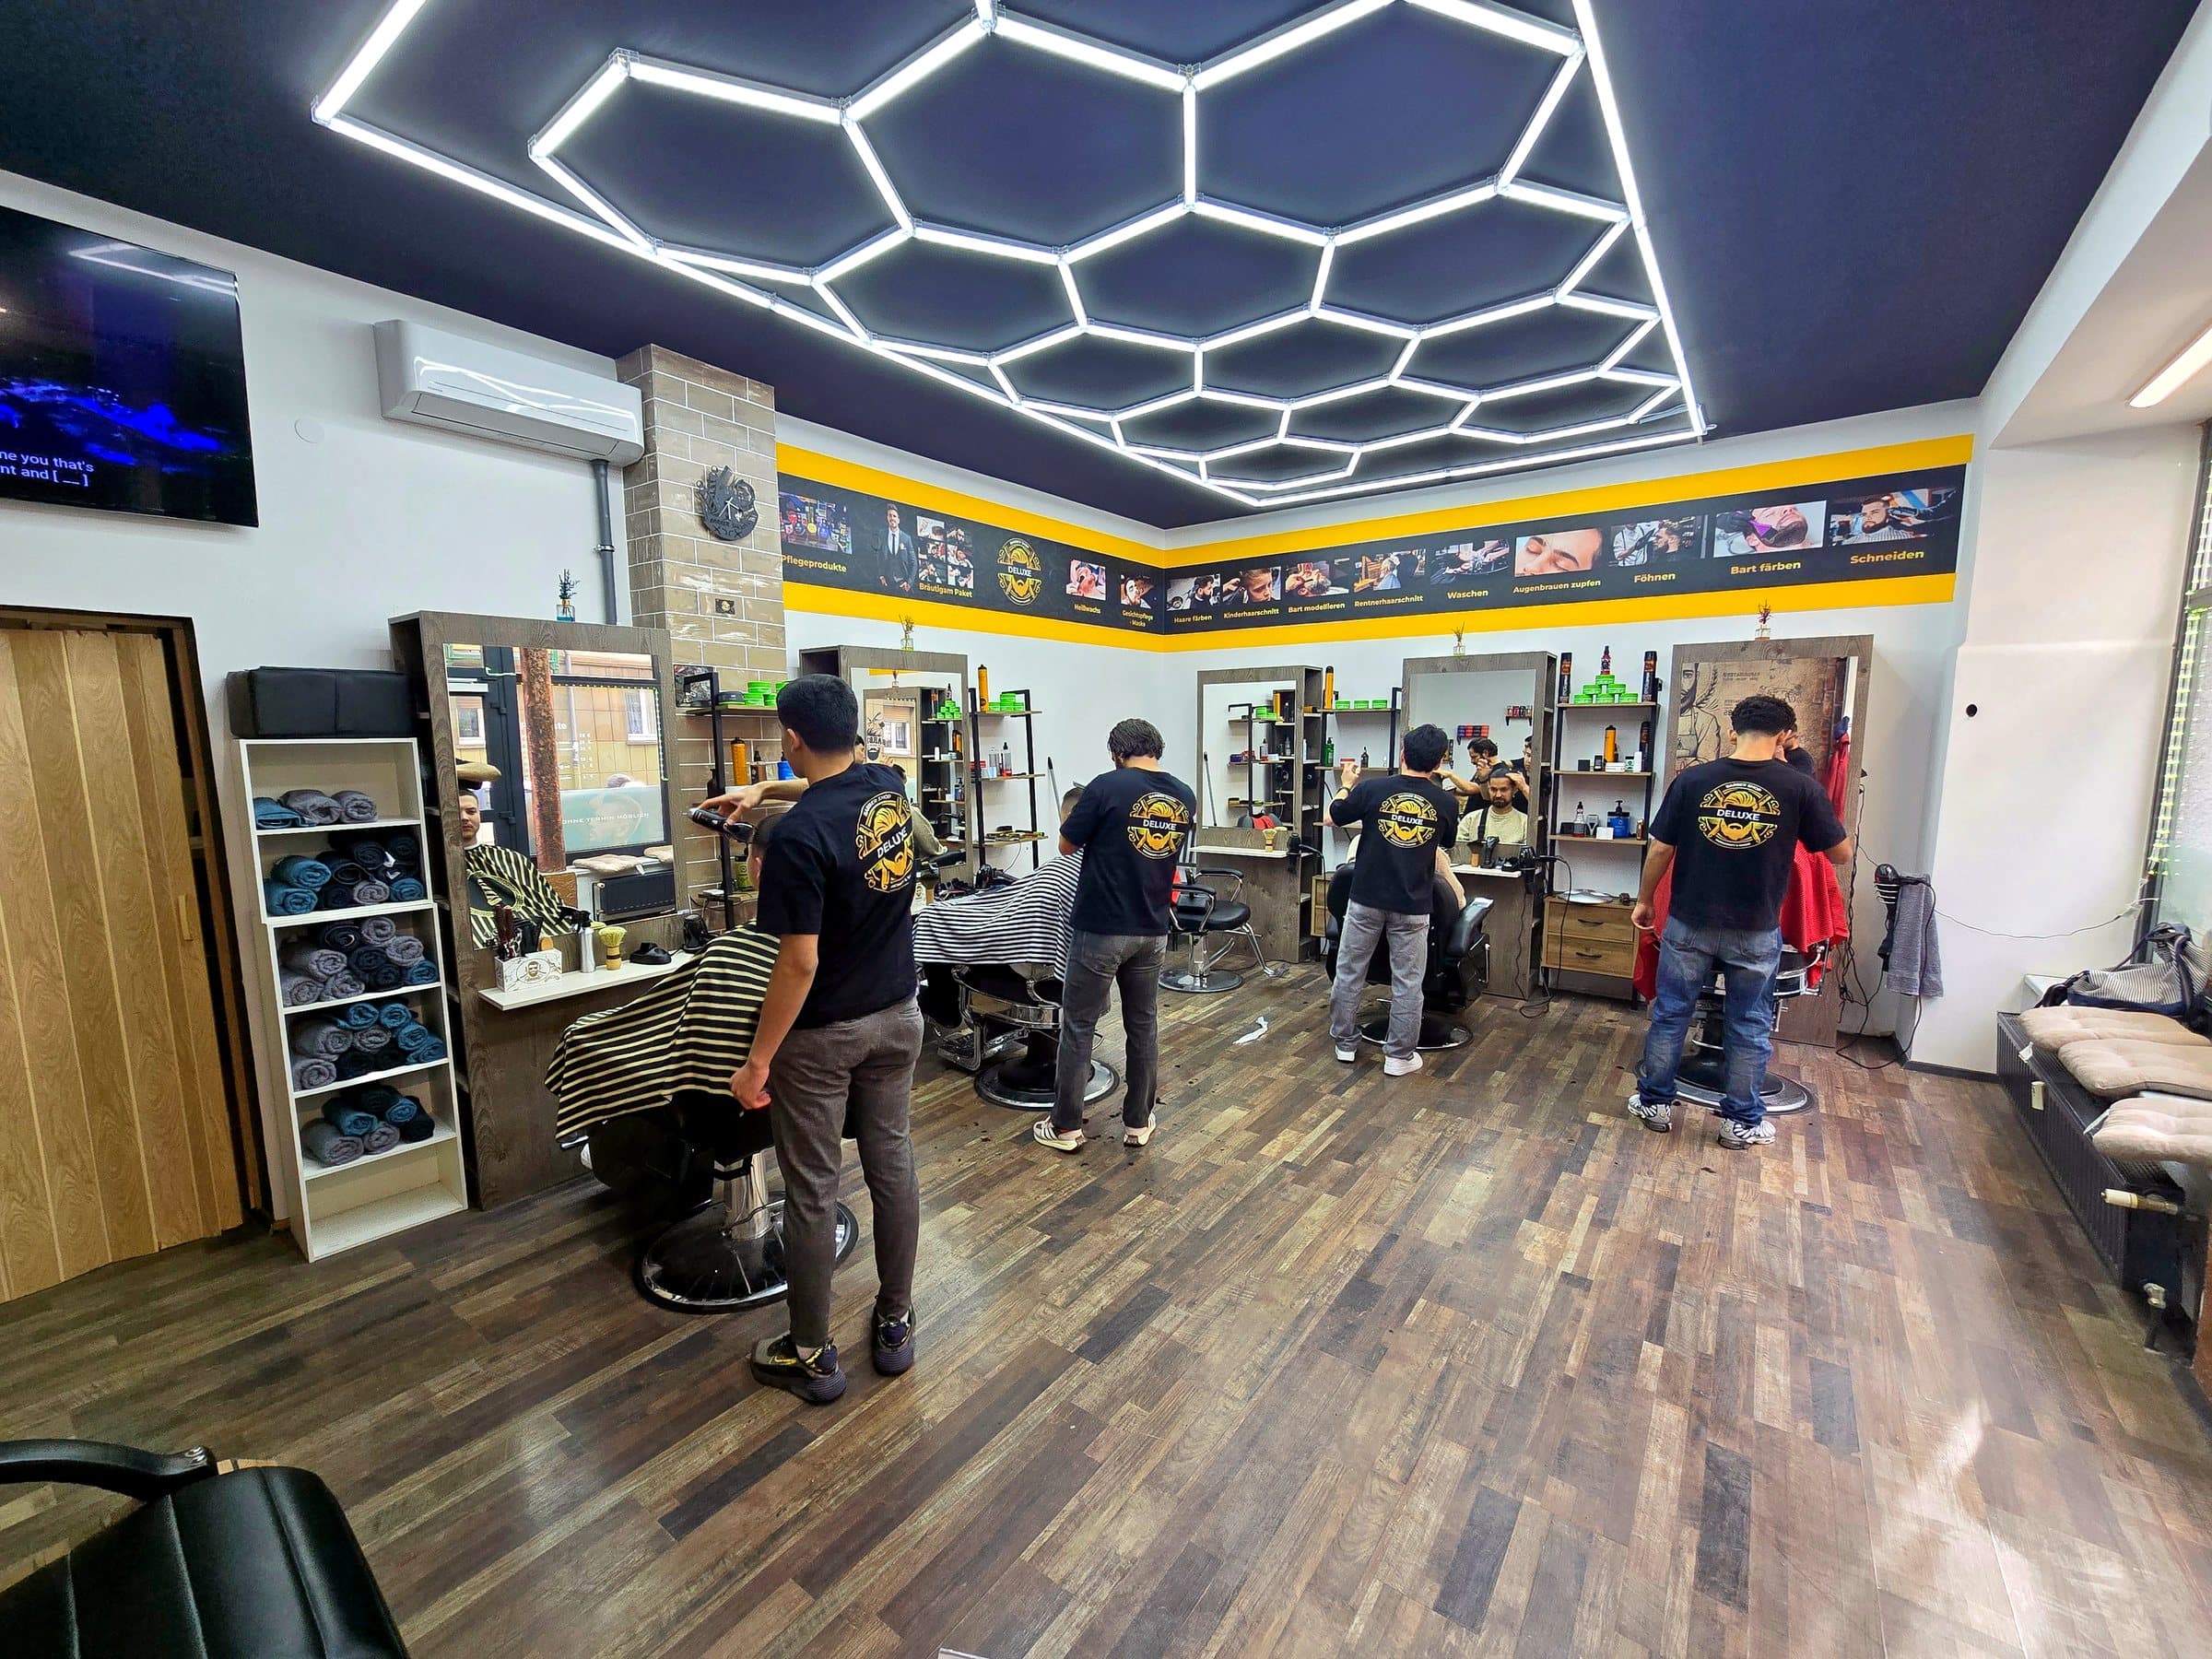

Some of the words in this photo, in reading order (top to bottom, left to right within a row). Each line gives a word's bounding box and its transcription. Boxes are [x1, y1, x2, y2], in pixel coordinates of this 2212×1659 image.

[20, 453, 49, 465] you
[53, 457, 94, 472] that's
[21, 468, 49, 479] and
[1850, 549, 1924, 564] Schneiden
[1007, 565, 1032, 577] DELUXE
[1730, 564, 1757, 574] Bart
[1759, 560, 1801, 572] färben
[1634, 571, 1676, 583] Föhnen
[919, 582, 954, 594] Bräutigam
[954, 588, 973, 598] Paket
[1512, 582, 1570, 594] Augenbrauen
[1571, 579, 1602, 591] zupfen
[1447, 588, 1488, 600] Waschen
[1305, 602, 1346, 612] modellieren
[1354, 594, 1424, 608] Rentnerhaarschnitt
[1193, 614, 1213, 622] färben
[1223, 607, 1279, 618] Kinderhaarschnitt
[1391, 814, 1424, 825] DELUXE
[1716, 809, 1761, 821] DELUXE
[1143, 819, 1177, 830] DELUXE
